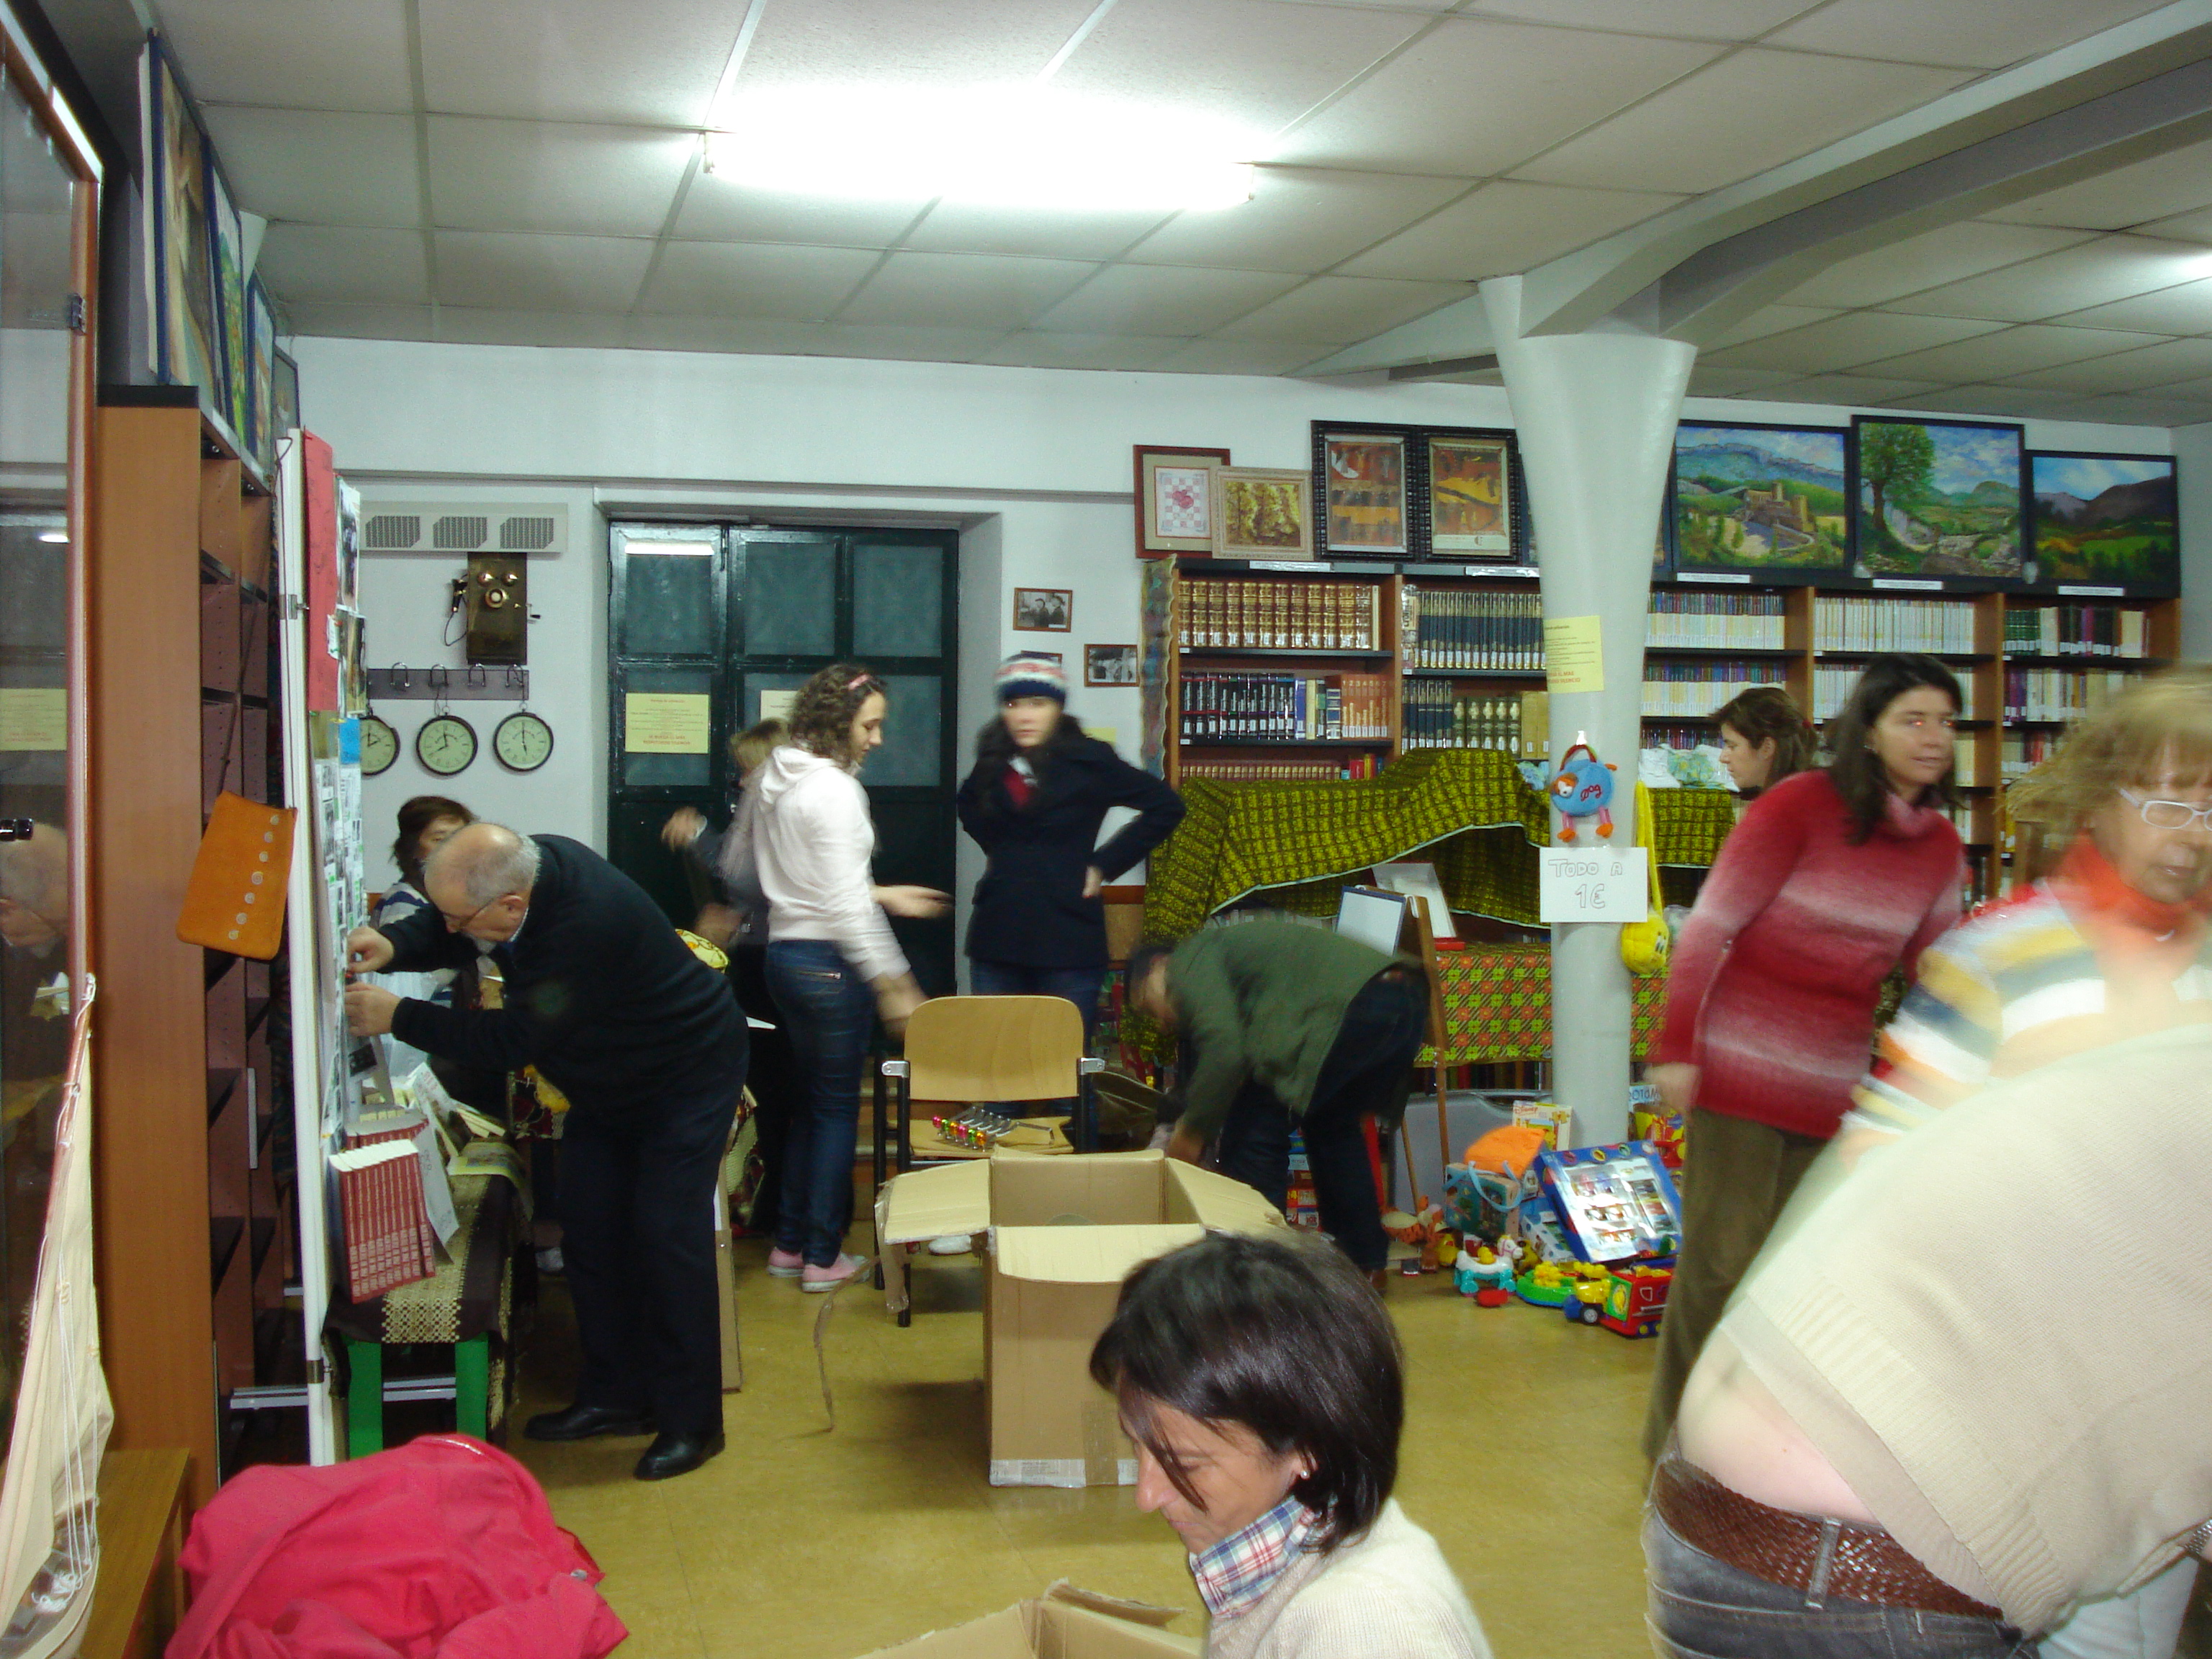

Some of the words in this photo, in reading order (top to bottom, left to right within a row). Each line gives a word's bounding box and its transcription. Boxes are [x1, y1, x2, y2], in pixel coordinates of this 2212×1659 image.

[1548, 858, 1599, 878] TODO
[1610, 862, 1623, 876] A
[1575, 884, 1606, 909] 1€
